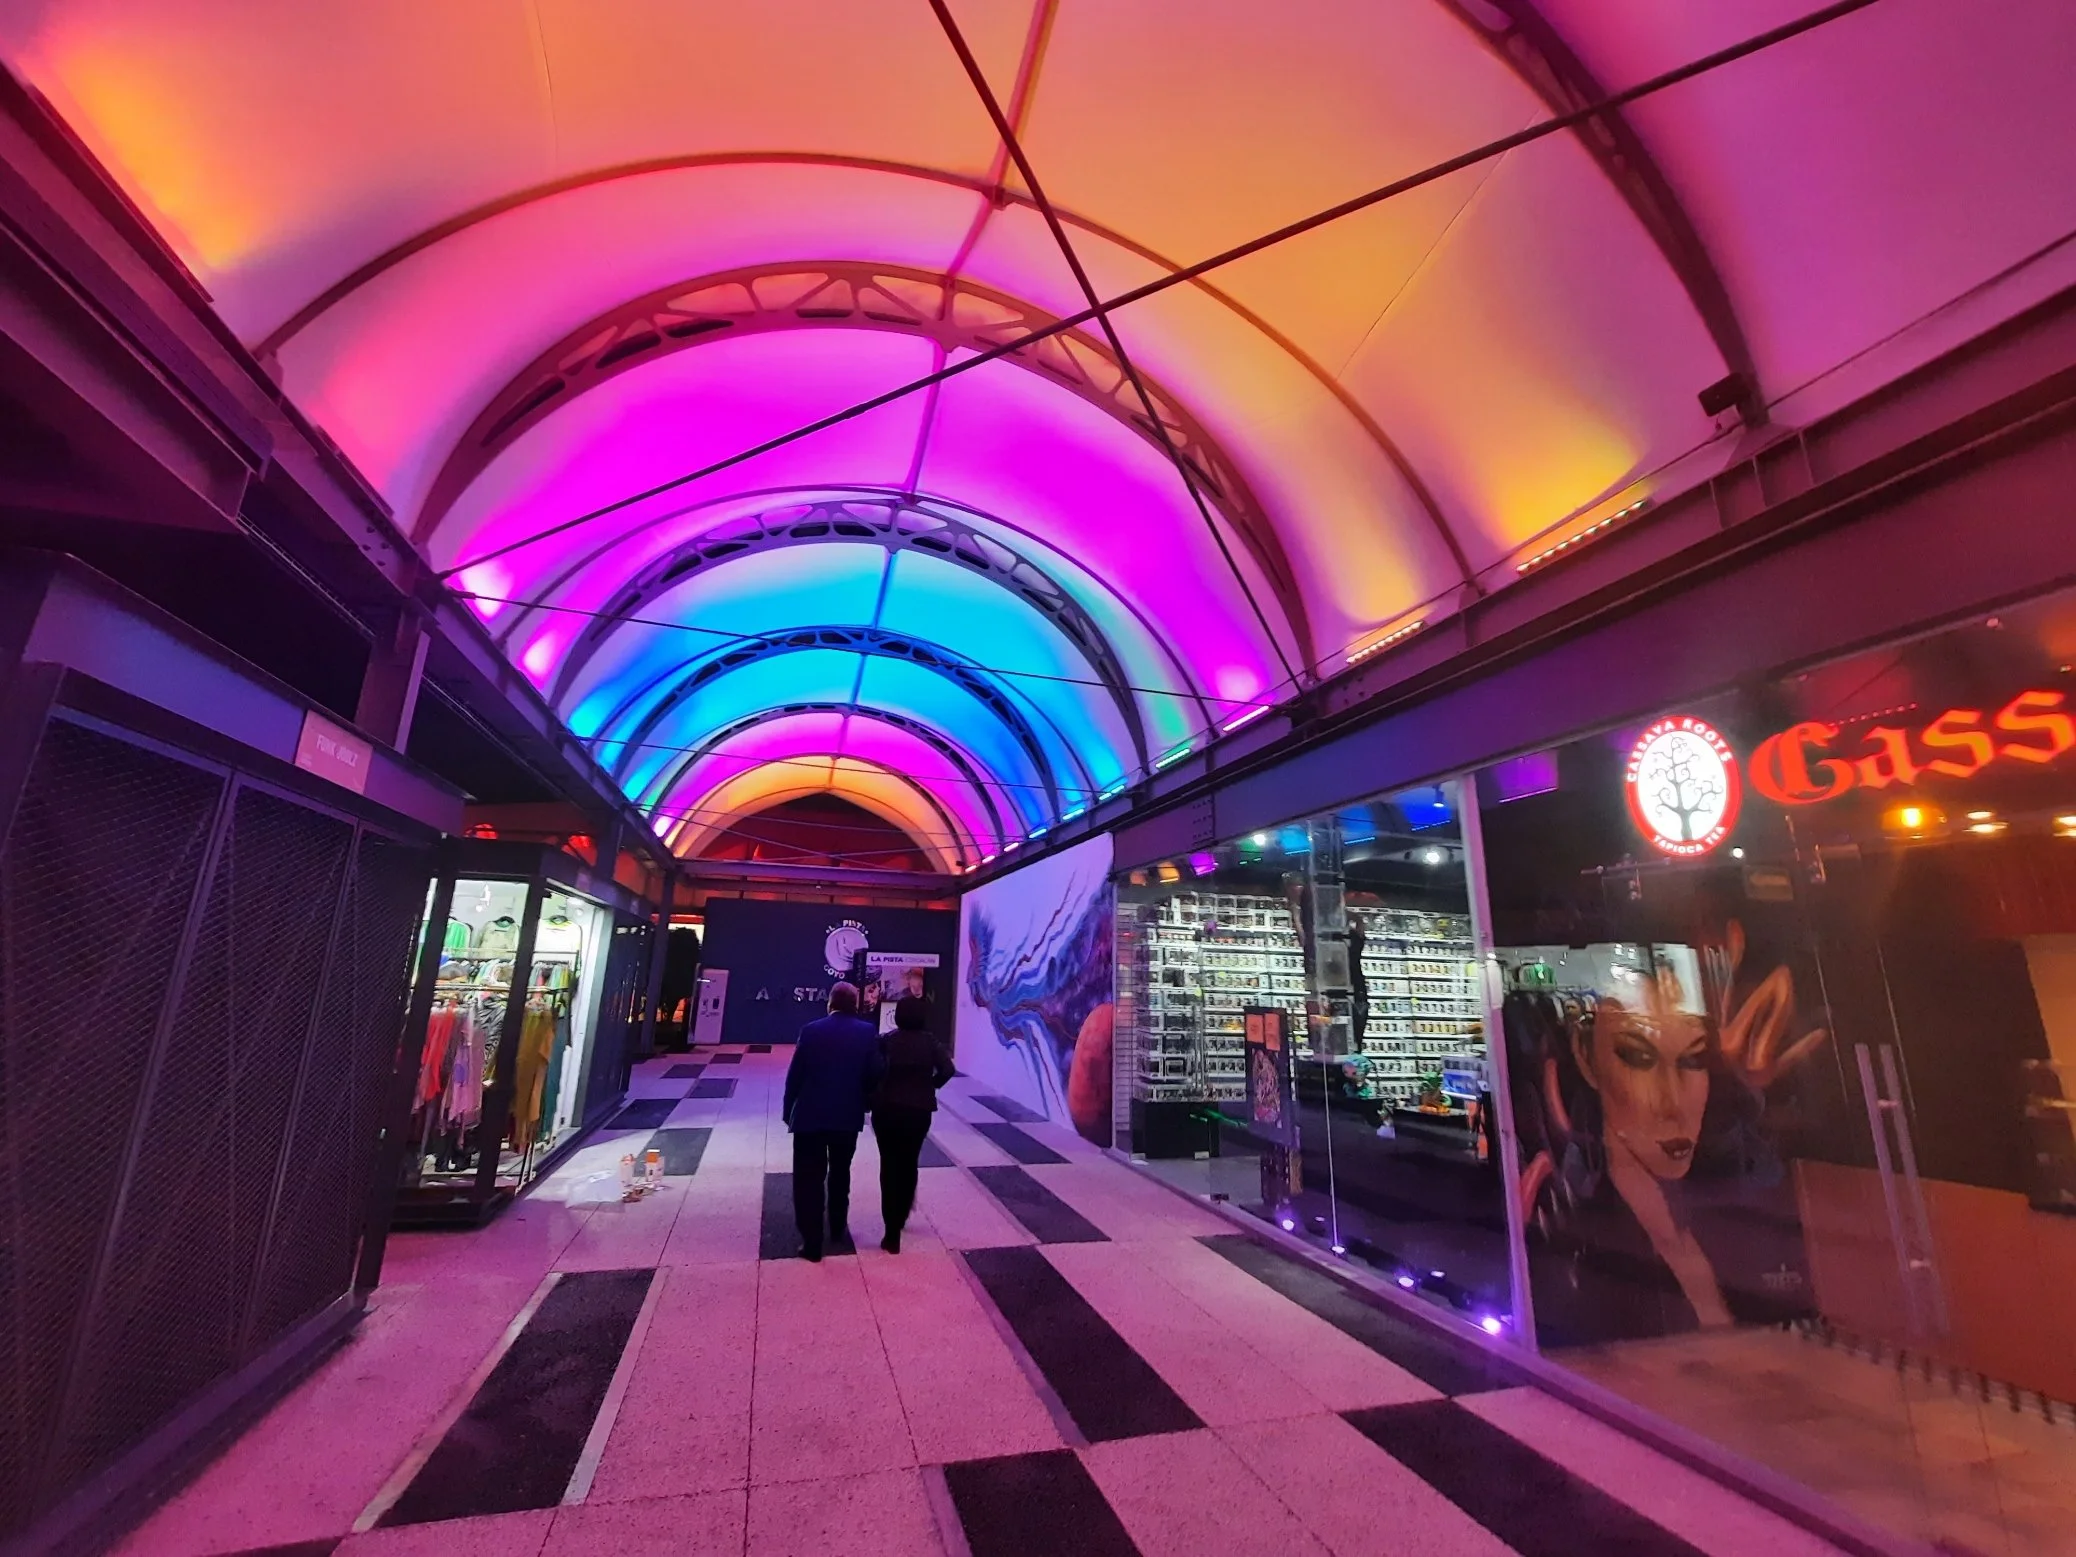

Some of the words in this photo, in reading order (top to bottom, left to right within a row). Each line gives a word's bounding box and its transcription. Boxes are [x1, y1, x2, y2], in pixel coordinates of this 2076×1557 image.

[1626, 720, 1676, 782] CASSAVA
[1682, 718, 1733, 762] ROOTS
[1653, 834, 1704, 854] TAPIOCA
[1705, 826, 1726, 845] TEA
